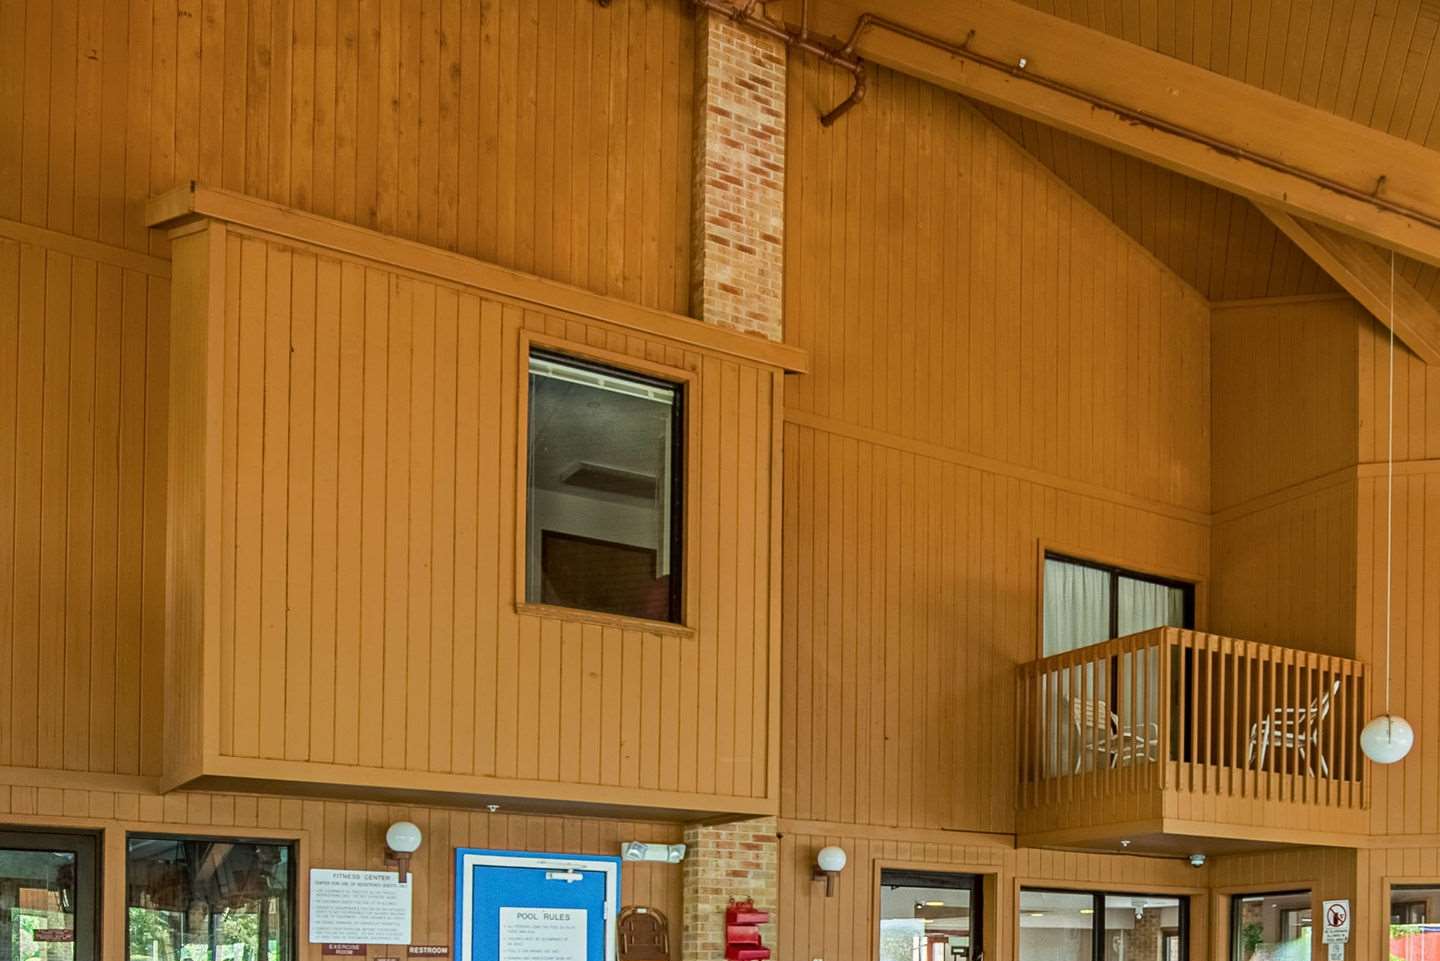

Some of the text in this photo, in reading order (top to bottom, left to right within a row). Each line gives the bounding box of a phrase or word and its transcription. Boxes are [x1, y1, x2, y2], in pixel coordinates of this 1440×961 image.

[516, 912, 571, 921] POOL RULES
[408, 946, 449, 954] RESTROOM
